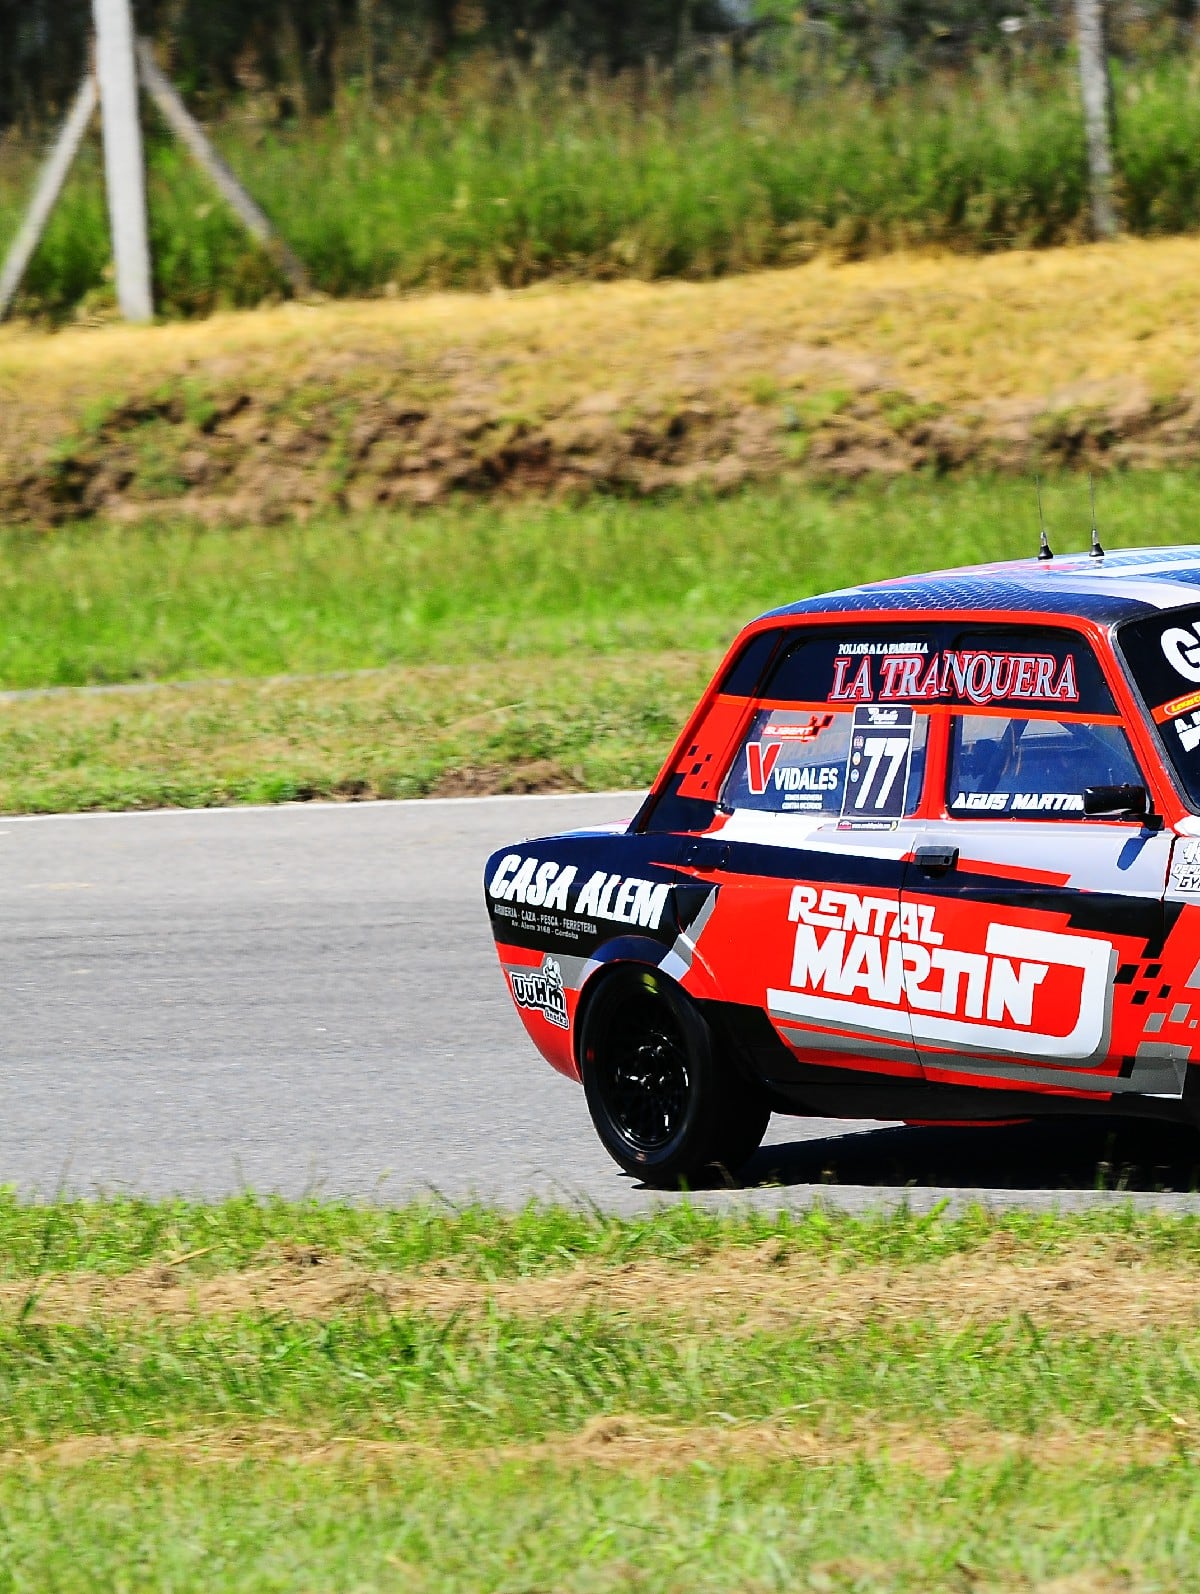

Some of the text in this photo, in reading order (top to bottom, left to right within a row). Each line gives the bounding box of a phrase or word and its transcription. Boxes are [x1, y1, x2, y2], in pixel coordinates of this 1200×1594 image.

[838, 644, 869, 654] POLLOS
[876, 644, 888, 654] LA
[828, 650, 1079, 705] LA TRANQUERA
[774, 767, 839, 790] VIDALES
[855, 738, 909, 808] 77
[952, 792, 1084, 810] AGUS MARTIN
[489, 854, 671, 930] CASA ALEM
[521, 910, 536, 922] CAZA
[540, 914, 559, 927] PESCA
[787, 885, 944, 945] RENTAL
[790, 923, 1050, 1026] MARTIN
